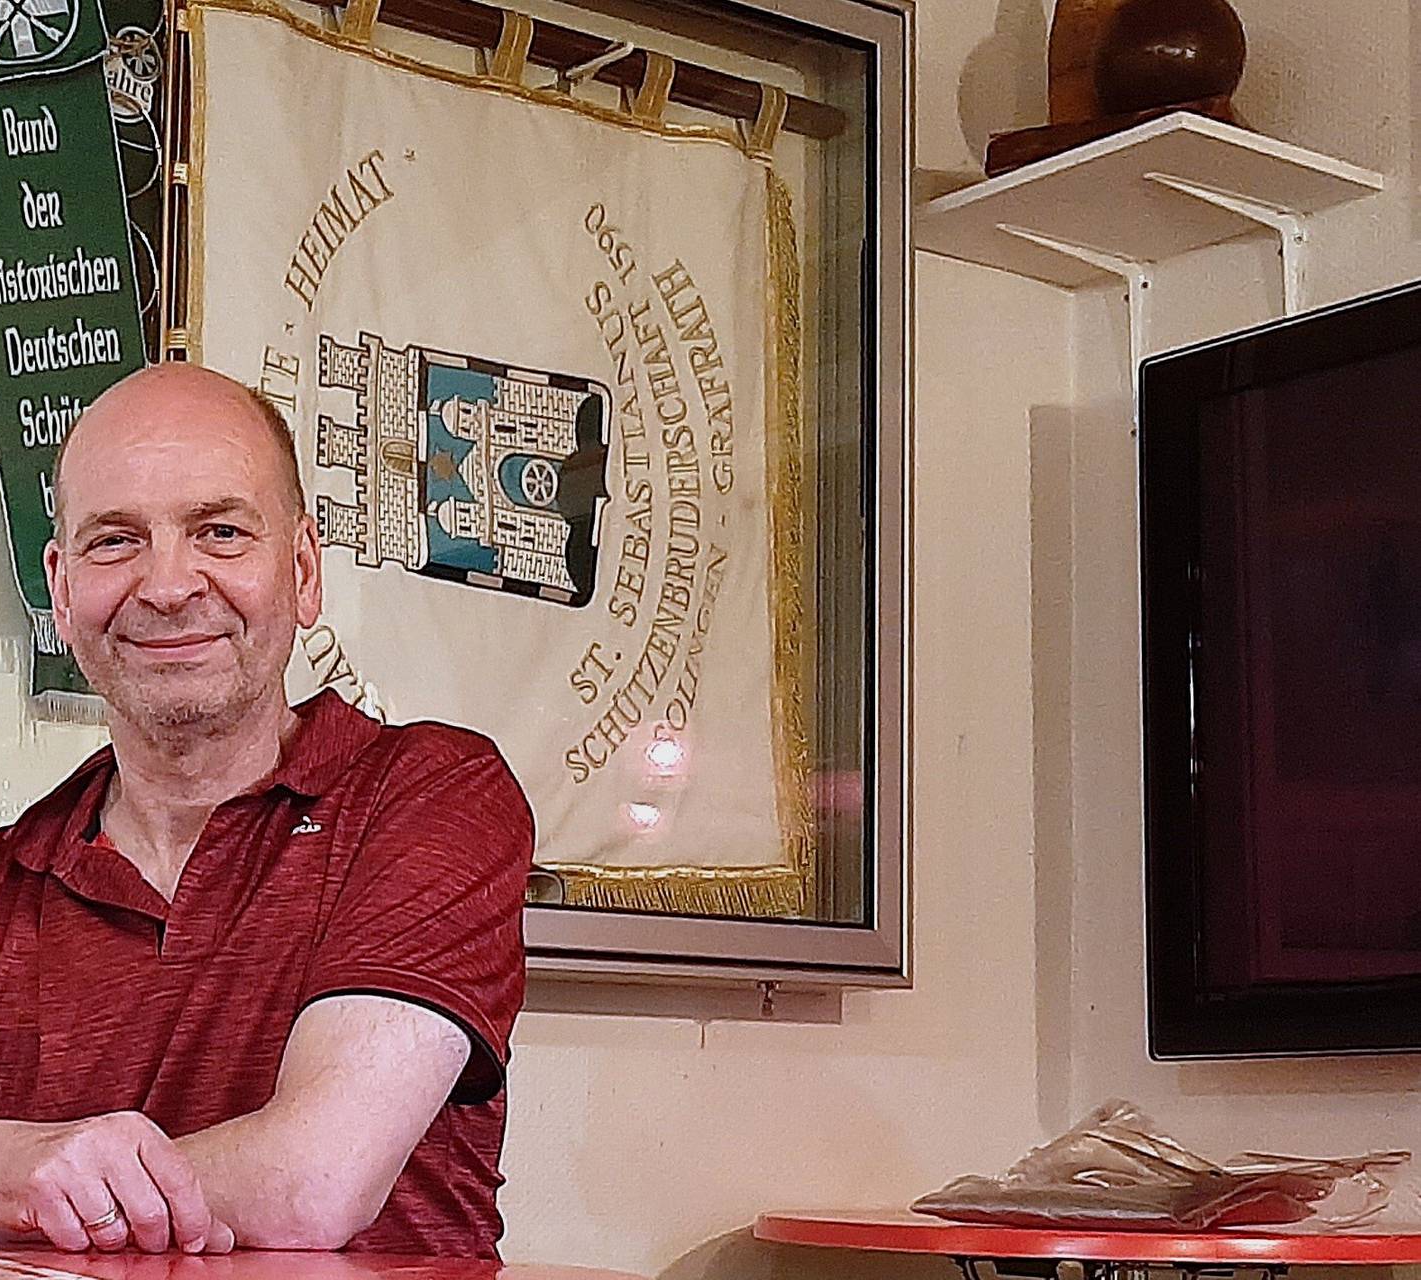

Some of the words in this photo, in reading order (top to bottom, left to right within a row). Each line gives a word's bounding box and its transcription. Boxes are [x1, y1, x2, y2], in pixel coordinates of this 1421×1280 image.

[2, 105, 59, 156] Bund
[20, 181, 63, 228] der
[284, 149, 395, 313] HEIMAT
[584, 203, 637, 285] 1590
[4, 318, 121, 377] Deutschen
[585, 281, 653, 627] SEBASTIANUS
[565, 299, 701, 784] SCHÜTZENBRUDERSCHAFT
[570, 642, 622, 705] ST.
